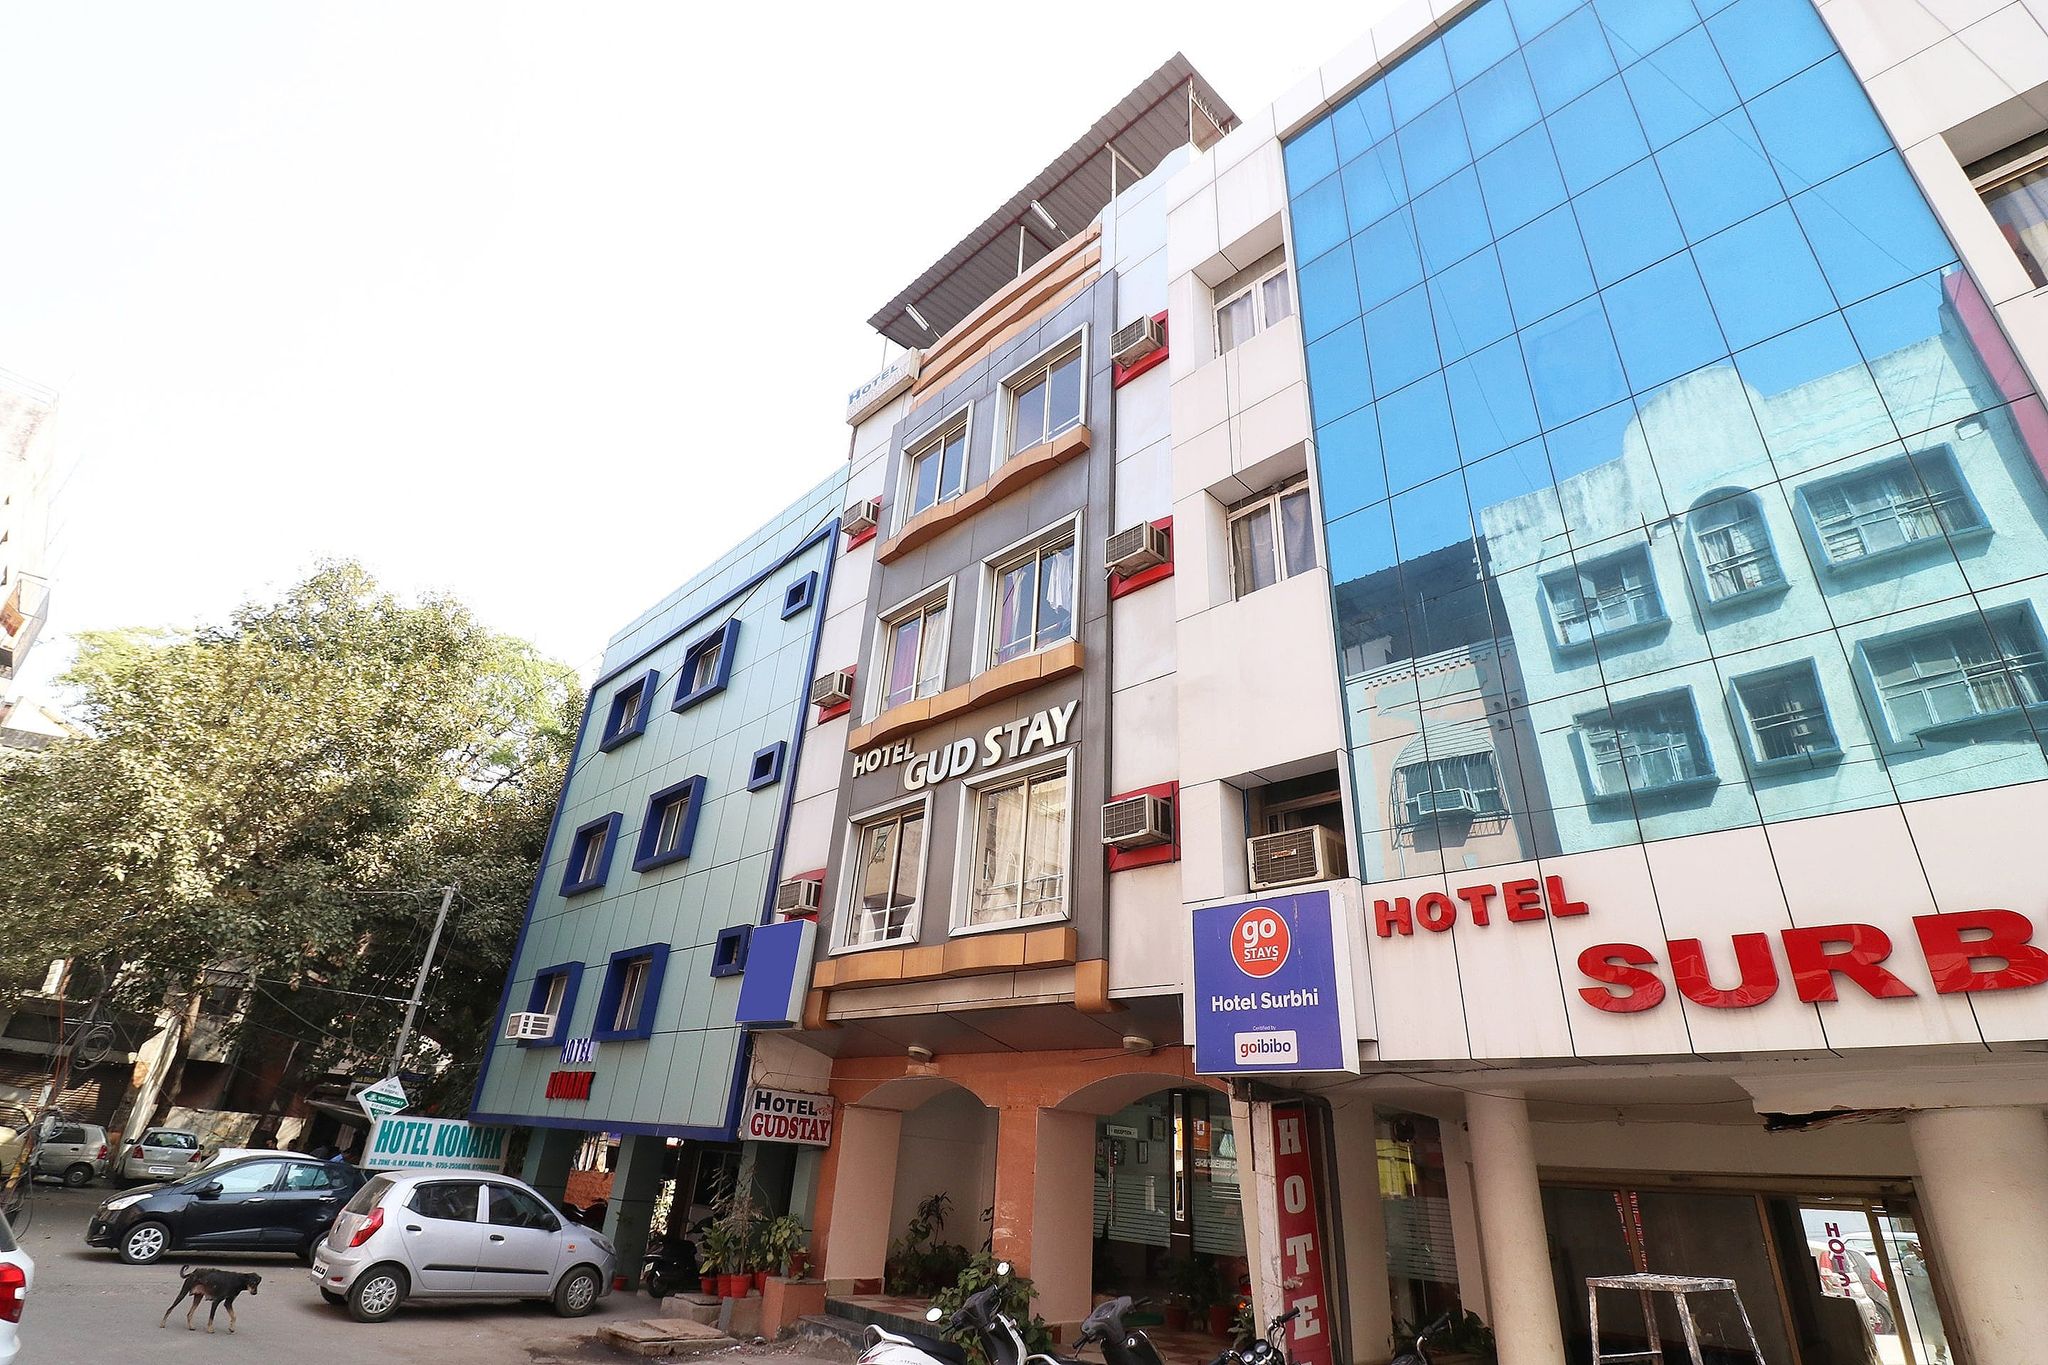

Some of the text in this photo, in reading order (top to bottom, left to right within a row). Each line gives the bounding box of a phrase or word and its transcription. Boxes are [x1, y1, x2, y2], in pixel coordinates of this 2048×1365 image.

[848, 365, 898, 405] HOTEL
[852, 700, 1080, 791] HOTEL GUD STAY
[1374, 875, 1590, 938] HOTEL
[1241, 918, 1277, 949] go
[1244, 945, 1279, 960] STAYS
[1577, 908, 2048, 1014] SURB
[1211, 988, 1319, 1012] Hotel Surbhi
[560, 1038, 592, 1063] HOTEL
[1240, 1038, 1292, 1058] goibibo
[755, 1091, 817, 1116] HOTEL
[374, 1120, 506, 1159] HOTEL KONARK
[751, 1113, 830, 1141] GUDSTAY
[1278, 1118, 1322, 1365] HOTE
